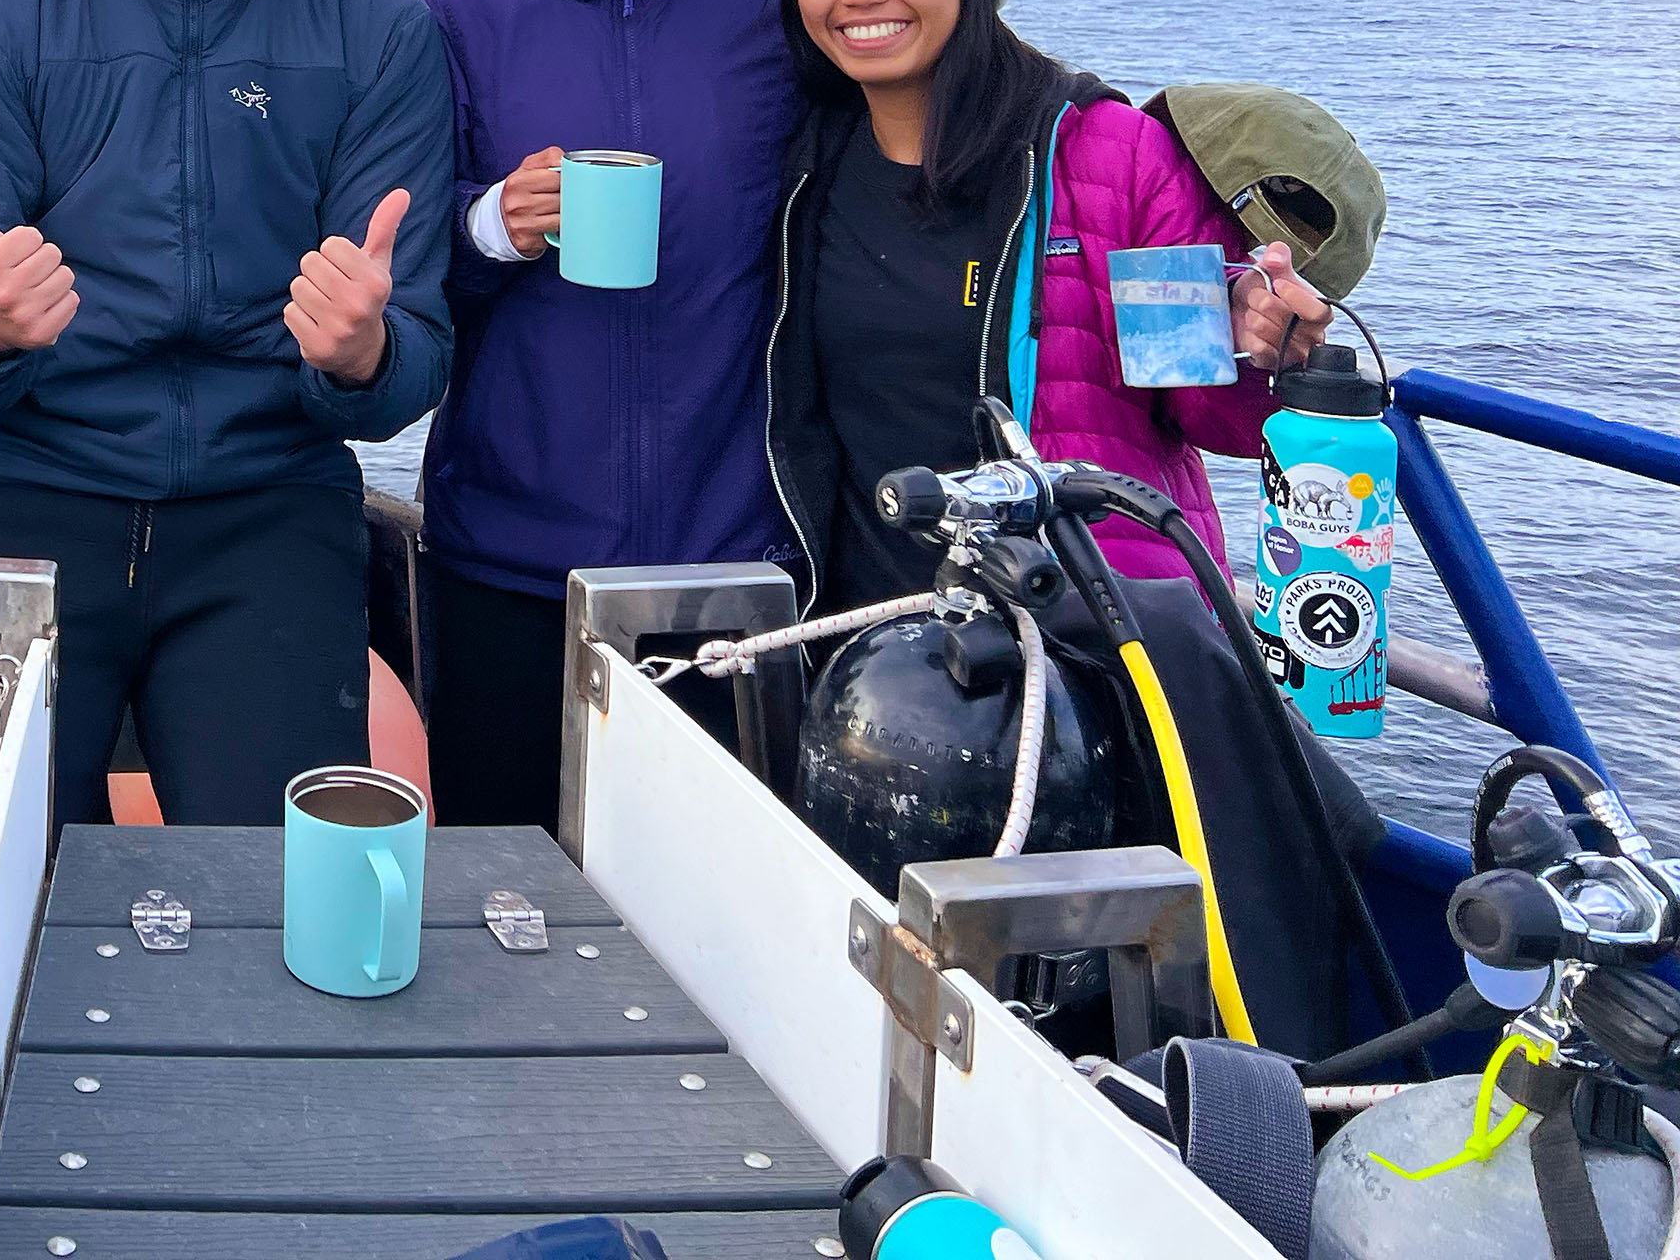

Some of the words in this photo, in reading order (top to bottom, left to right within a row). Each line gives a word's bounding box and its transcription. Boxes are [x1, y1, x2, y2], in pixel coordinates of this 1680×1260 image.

[1286, 518, 1316, 531] BOBA
[1319, 523, 1350, 534] GUYS
[1267, 532, 1288, 545] Legion
[1267, 541, 1274, 549] of
[1274, 543, 1295, 554] Honor
[1285, 579, 1322, 608] PARKS
[1328, 580, 1373, 618] PROJECT
